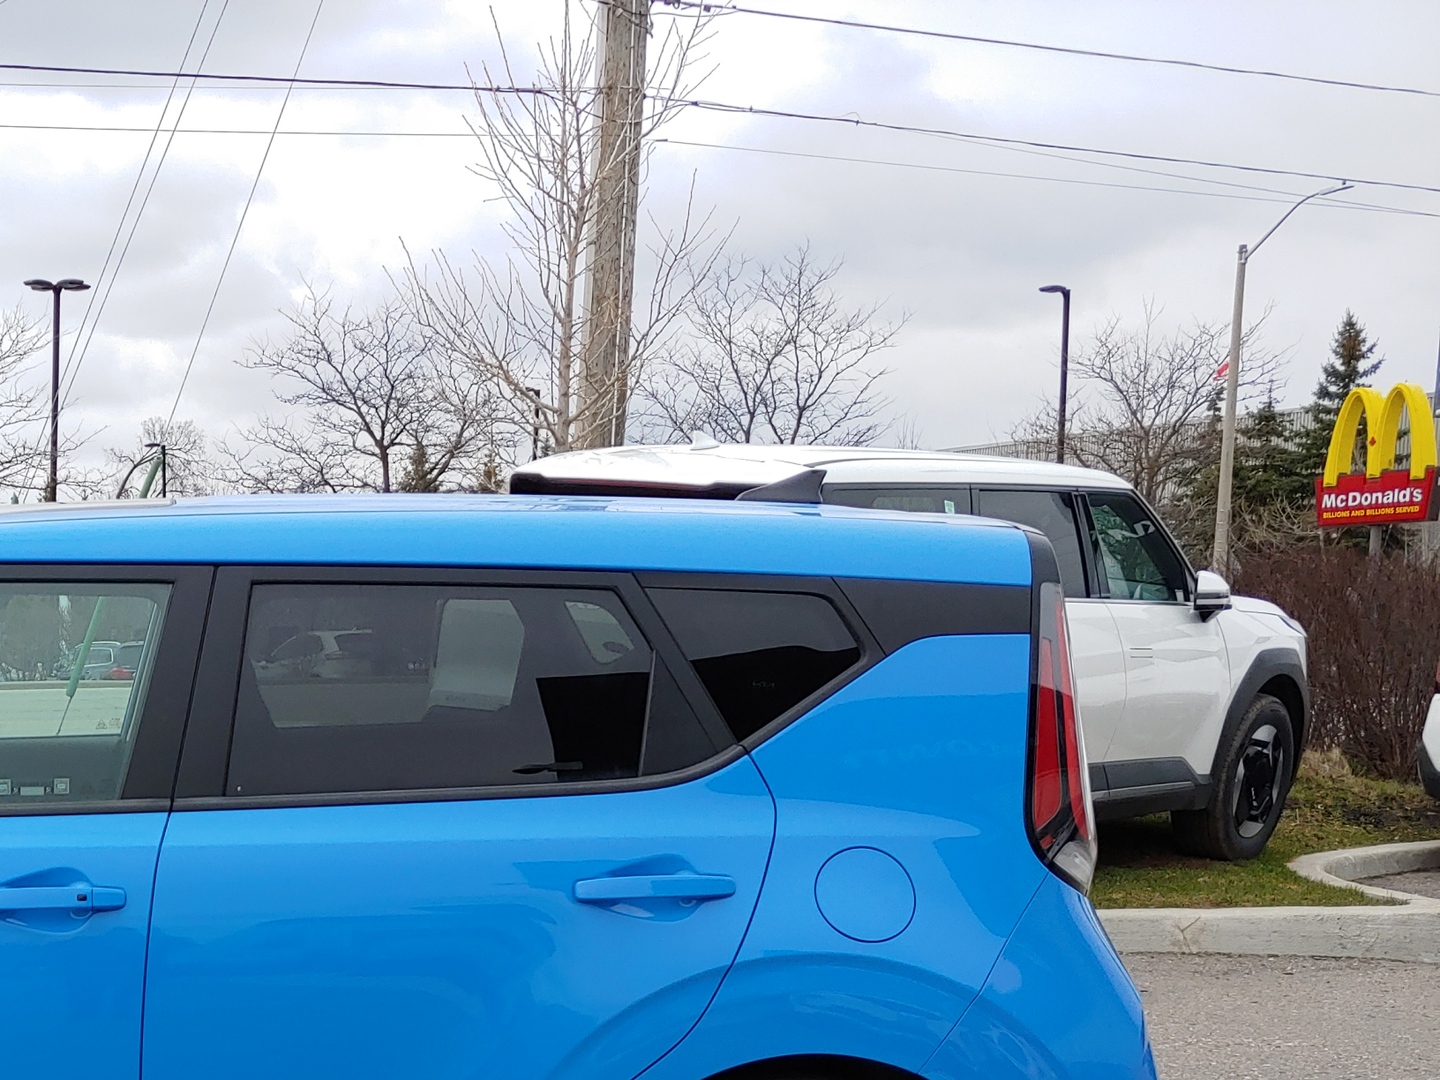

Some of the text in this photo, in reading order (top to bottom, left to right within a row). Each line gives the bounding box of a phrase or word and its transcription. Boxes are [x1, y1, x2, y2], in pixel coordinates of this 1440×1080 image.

[1322, 487, 1423, 508] McDonald's
[1323, 505, 1420, 519] BILLIONS AND BILLIONS SERVED
